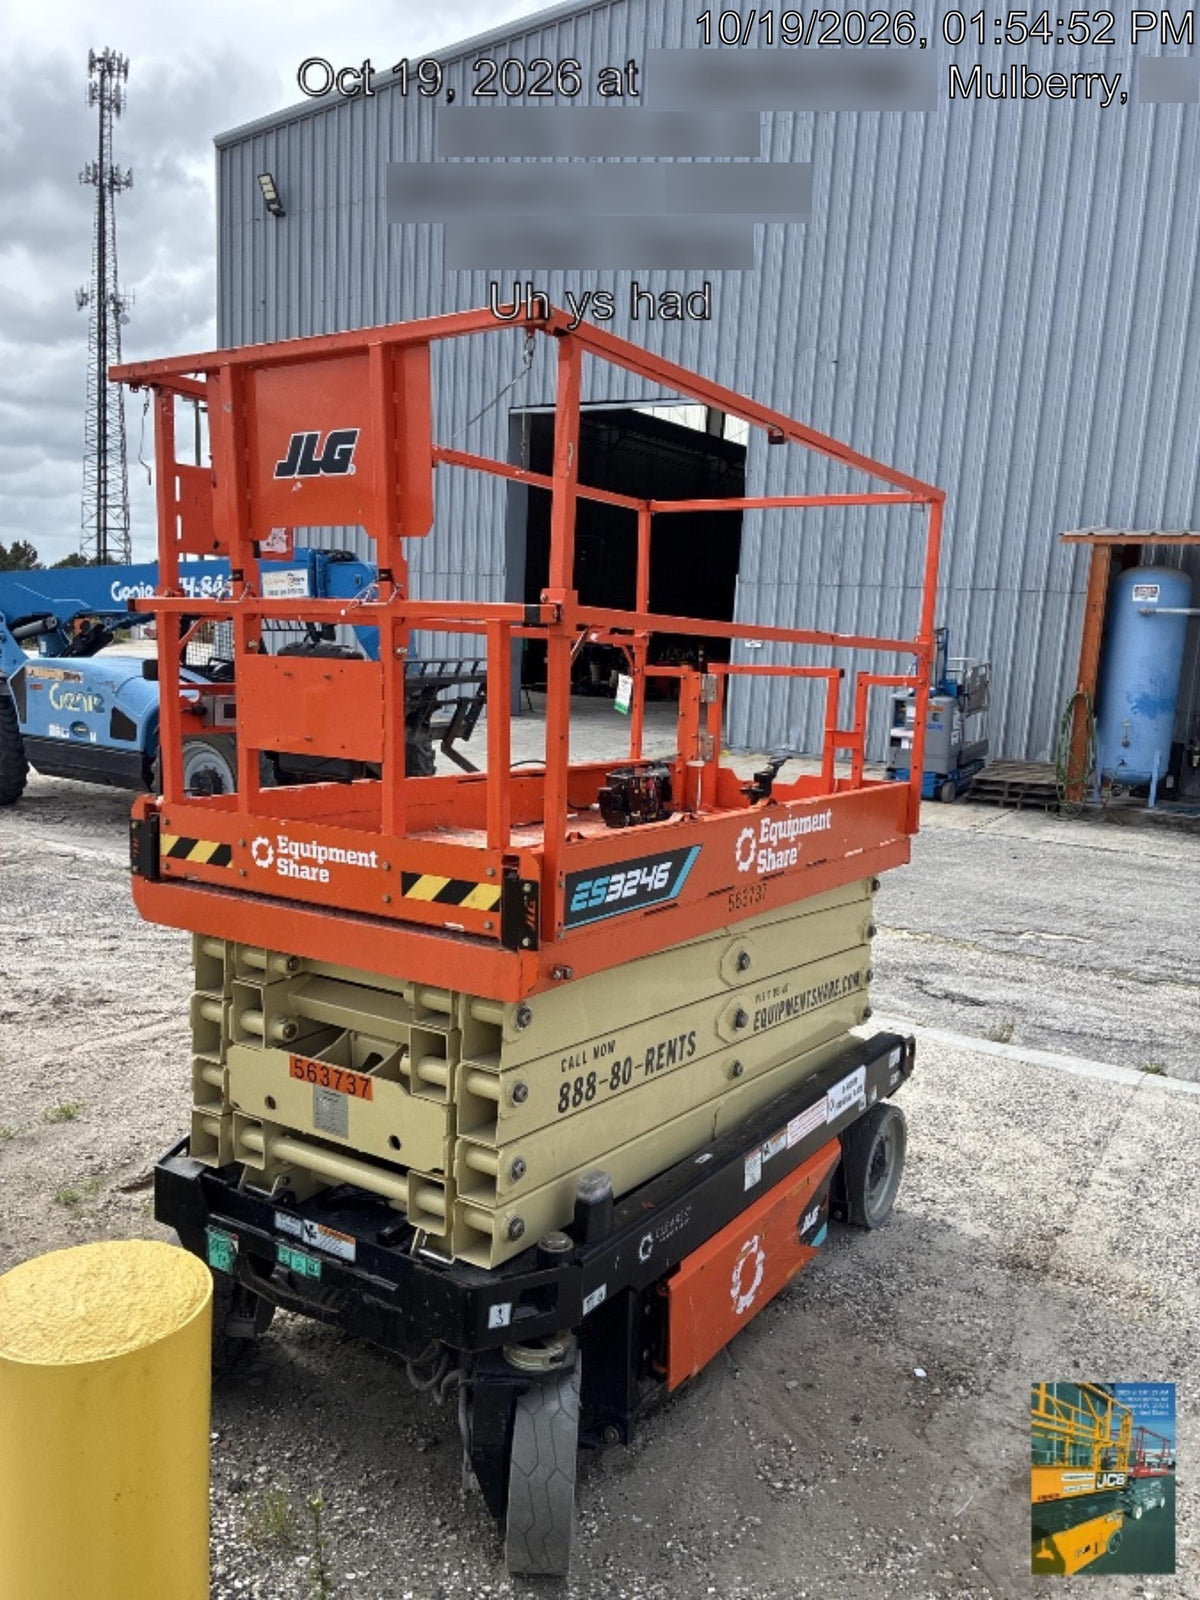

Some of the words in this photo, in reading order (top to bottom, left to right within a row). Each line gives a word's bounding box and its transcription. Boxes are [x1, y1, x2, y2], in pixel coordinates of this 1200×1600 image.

[273, 428, 361, 479] JLG
[110, 580, 156, 601] Genie
[49, 682, 106, 714] Genie
[758, 808, 833, 846] Equipment
[276, 835, 378, 869] Equipment
[757, 847, 798, 874] Share
[276, 857, 330, 883] Share
[570, 861, 673, 912] ES3246
[558, 1030, 696, 1113] 888-80-RENTS
[561, 1050, 588, 1072] CALL
[593, 1039, 616, 1060] NOW
[294, 1059, 372, 1099] 563737
